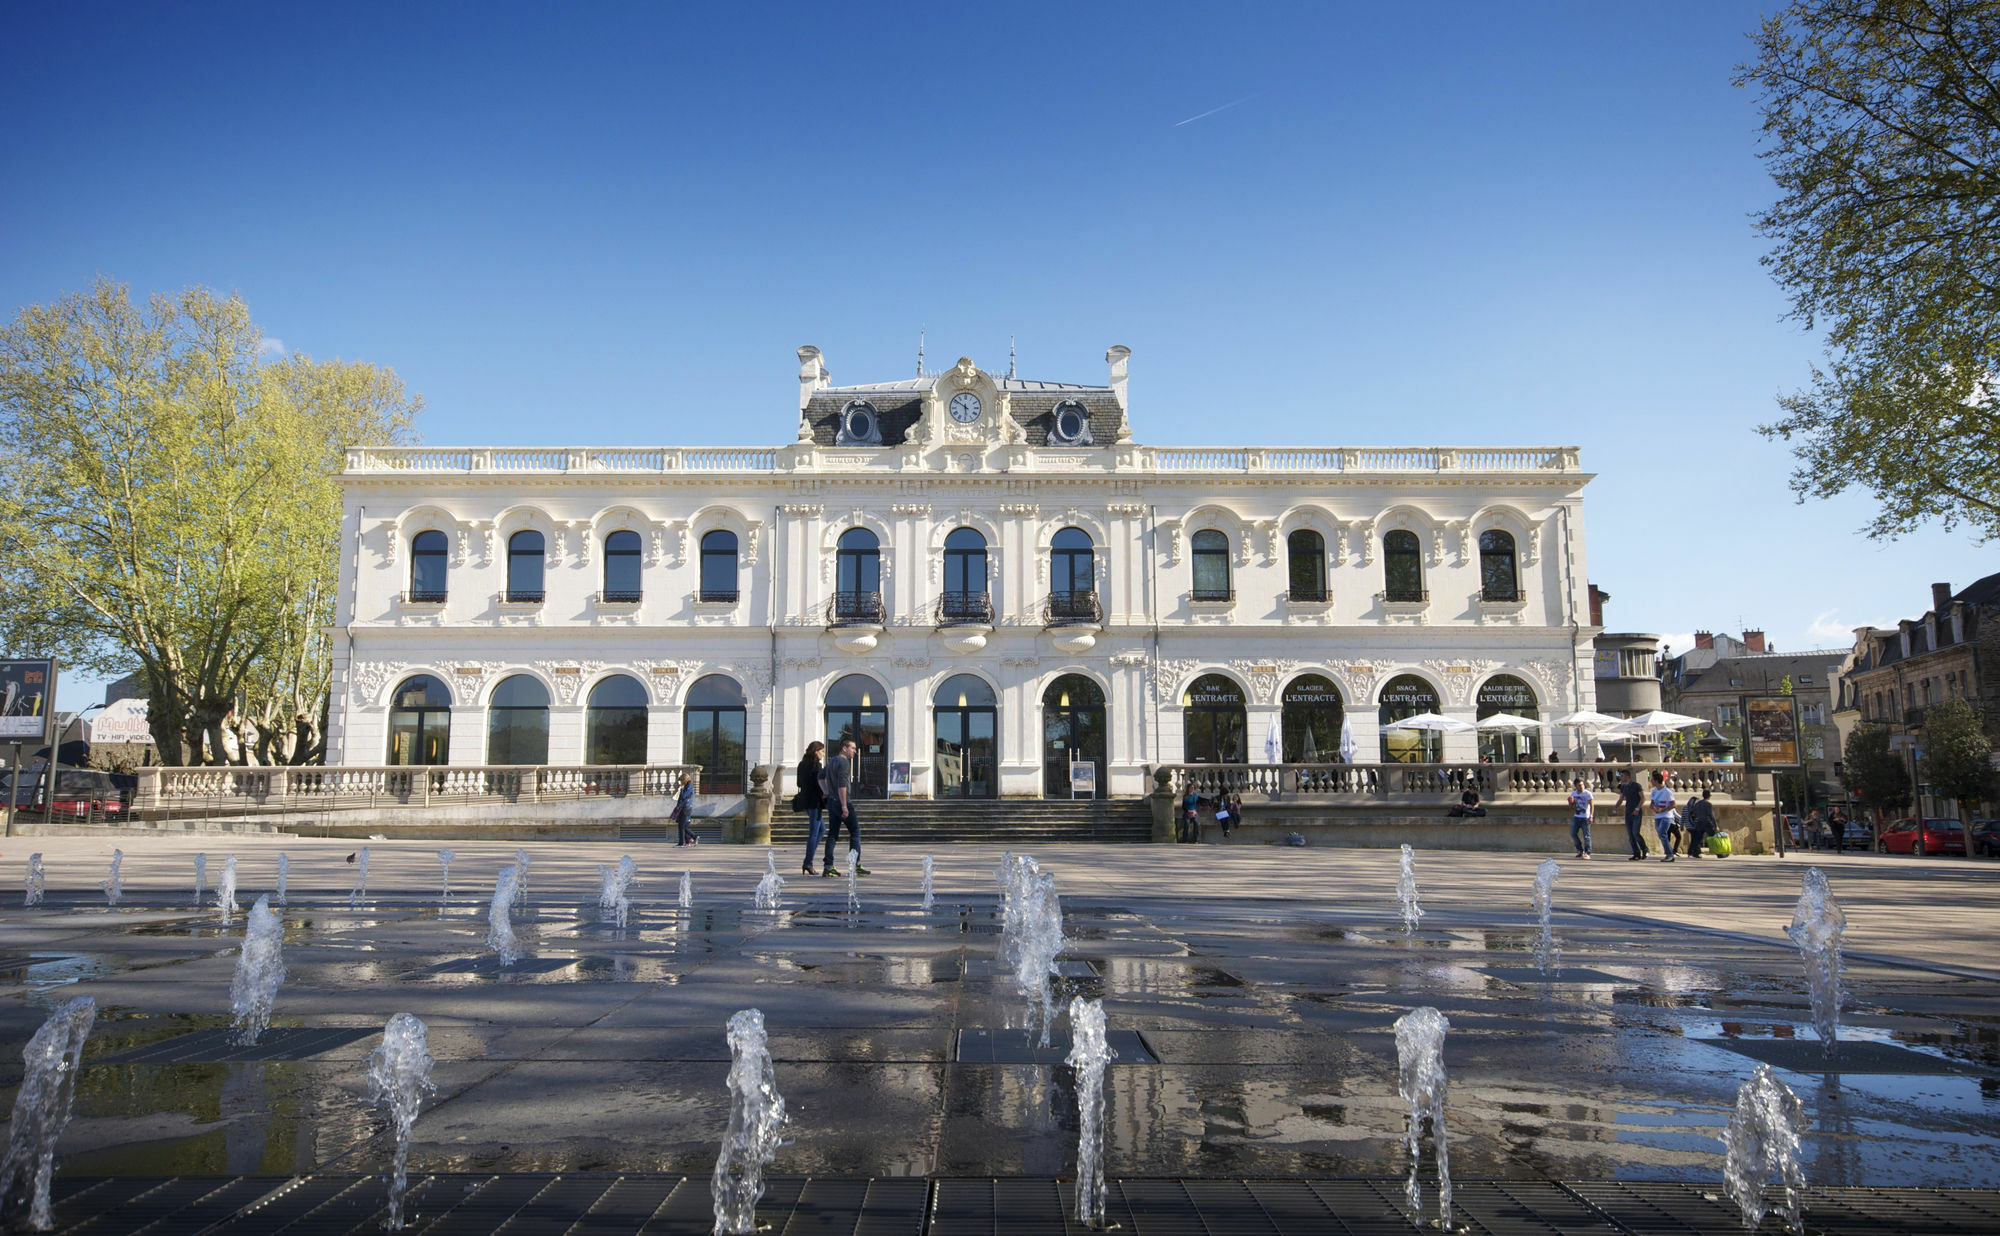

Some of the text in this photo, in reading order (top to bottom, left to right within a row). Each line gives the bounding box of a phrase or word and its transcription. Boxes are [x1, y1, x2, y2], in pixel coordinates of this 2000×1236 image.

[1285, 694, 1336, 702] L'ENTRACTE
[1383, 694, 1433, 702] L'ENTRACTE
[1480, 694, 1530, 702] L'ENTRACTE
